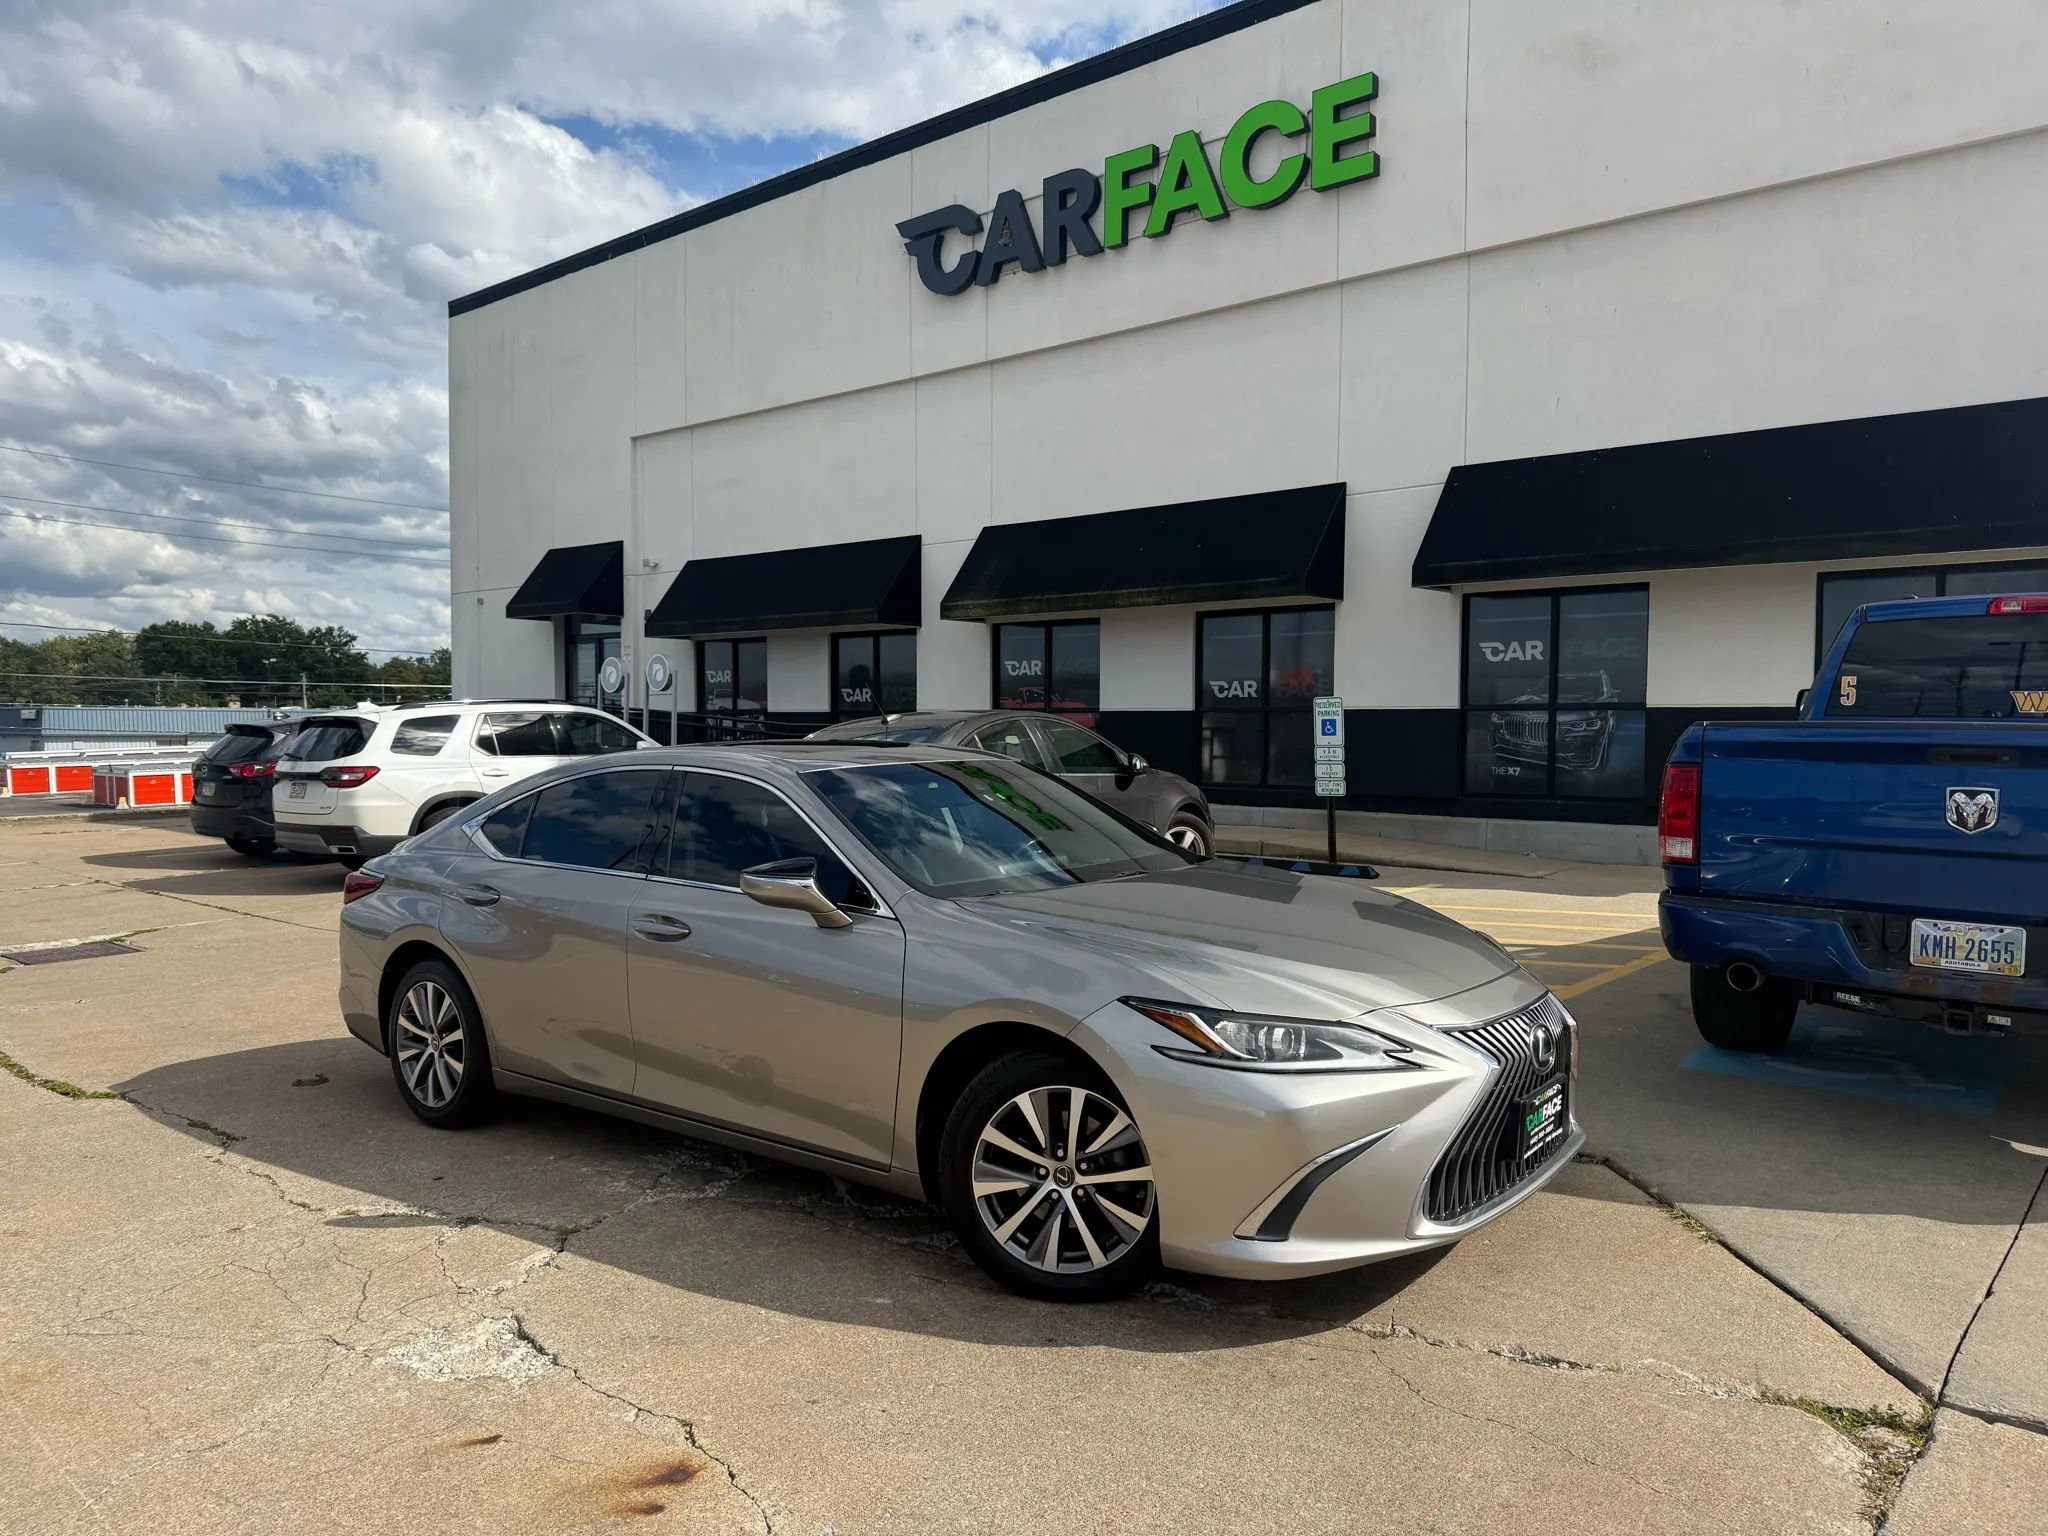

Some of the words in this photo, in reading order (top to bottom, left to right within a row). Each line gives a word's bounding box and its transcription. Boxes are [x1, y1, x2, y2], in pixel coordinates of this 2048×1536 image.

[896, 71, 1380, 296] CARFACE
[1478, 640, 1544, 662] CAR
[1004, 659, 1043, 676] CAR
[705, 670, 732, 684] CAR
[840, 687, 872, 703] CAR
[1209, 680, 1258, 698] CAR
[1840, 675, 1857, 706] 5
[1491, 767, 1507, 775] THE
[1507, 767, 1521, 776] X7
[1920, 933, 1957, 960] KMH
[1964, 938, 2015, 965] 2655
[1944, 960, 1981, 968] ASHTABULA
[1836, 992, 1861, 1002] REESE
[1526, 1094, 1562, 1132] CARFACE
